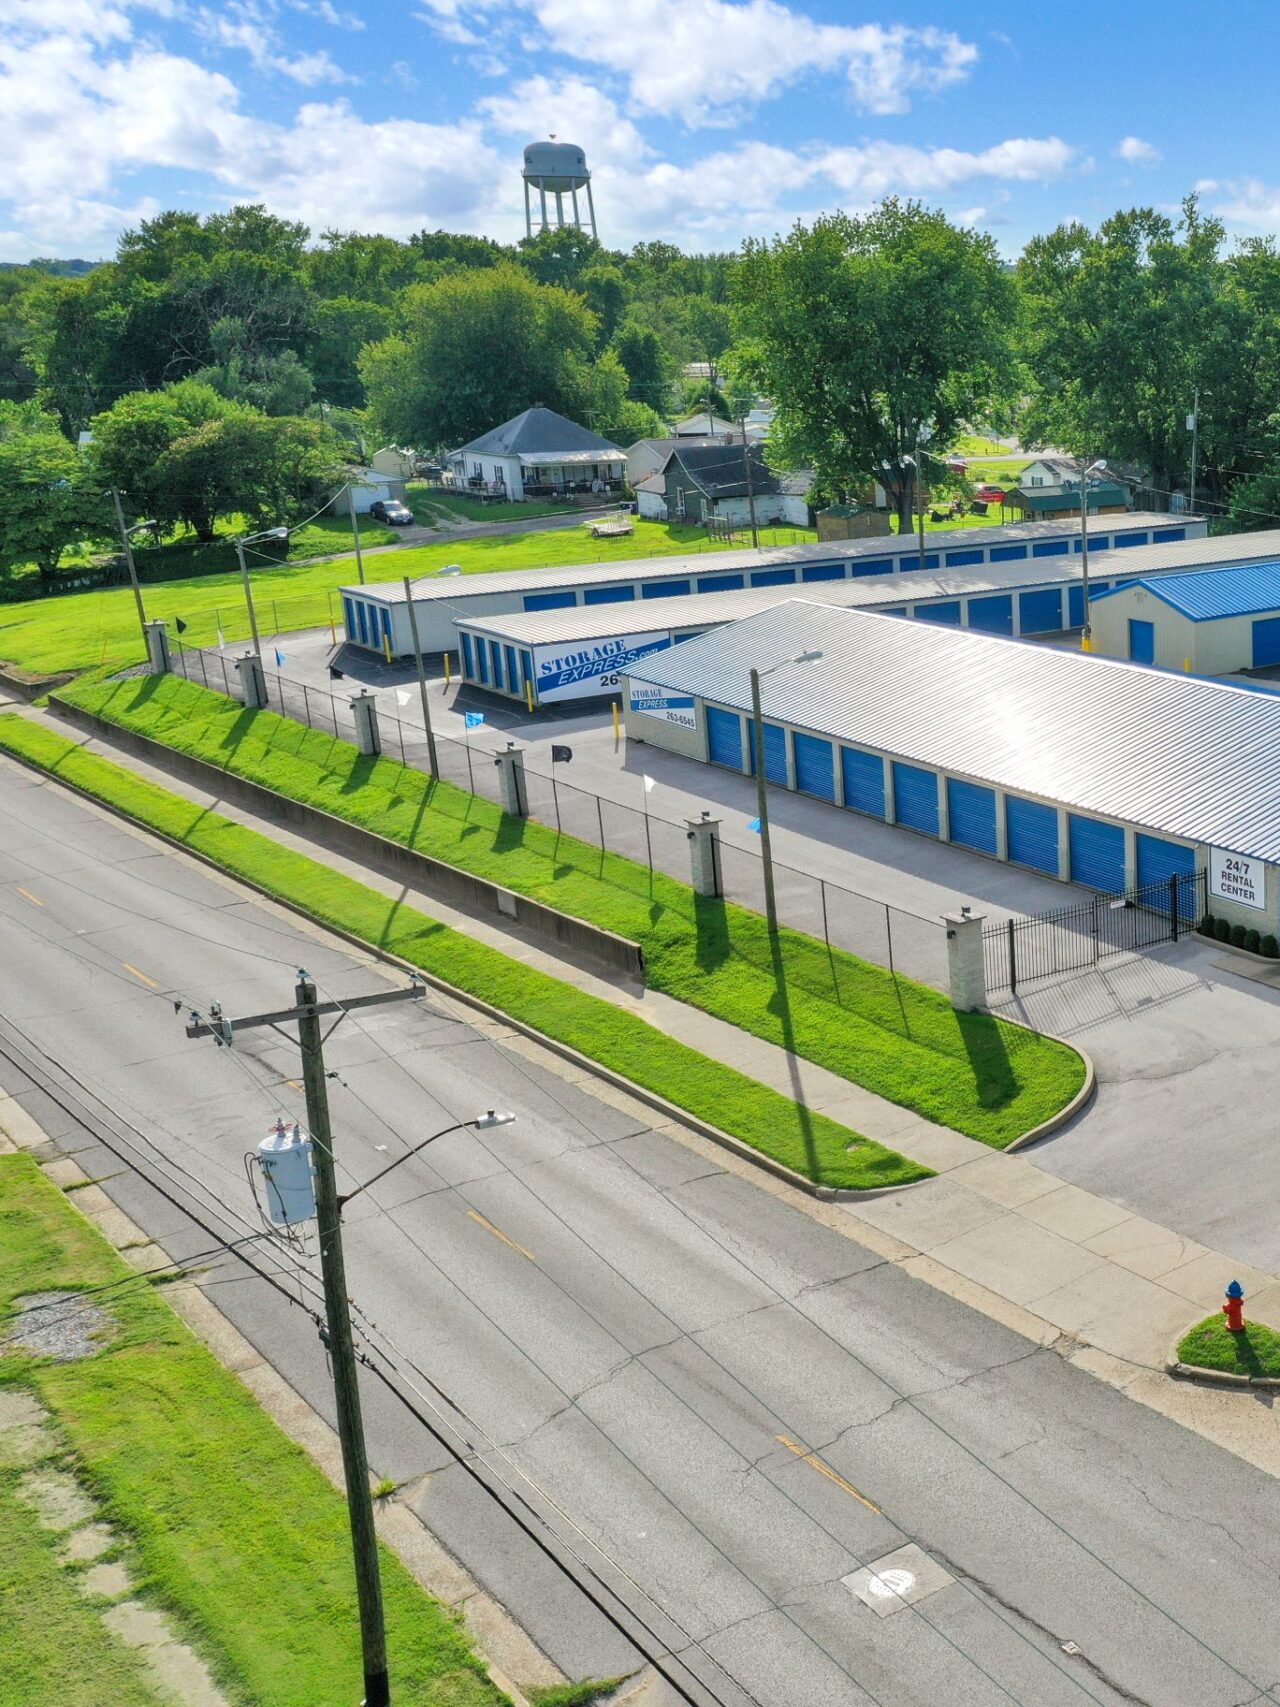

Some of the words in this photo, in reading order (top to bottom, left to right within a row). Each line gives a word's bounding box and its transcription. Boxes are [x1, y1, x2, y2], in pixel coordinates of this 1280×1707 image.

[541, 639, 627, 675] STORAGE
[600, 674, 622, 687] 26
[632, 688, 663, 699] STORAGE
[666, 711, 695, 728] 263-6545
[1226, 858, 1250, 875] 24/7
[1221, 870, 1255, 889] RENTAL
[1221, 882, 1255, 901] CENTER
